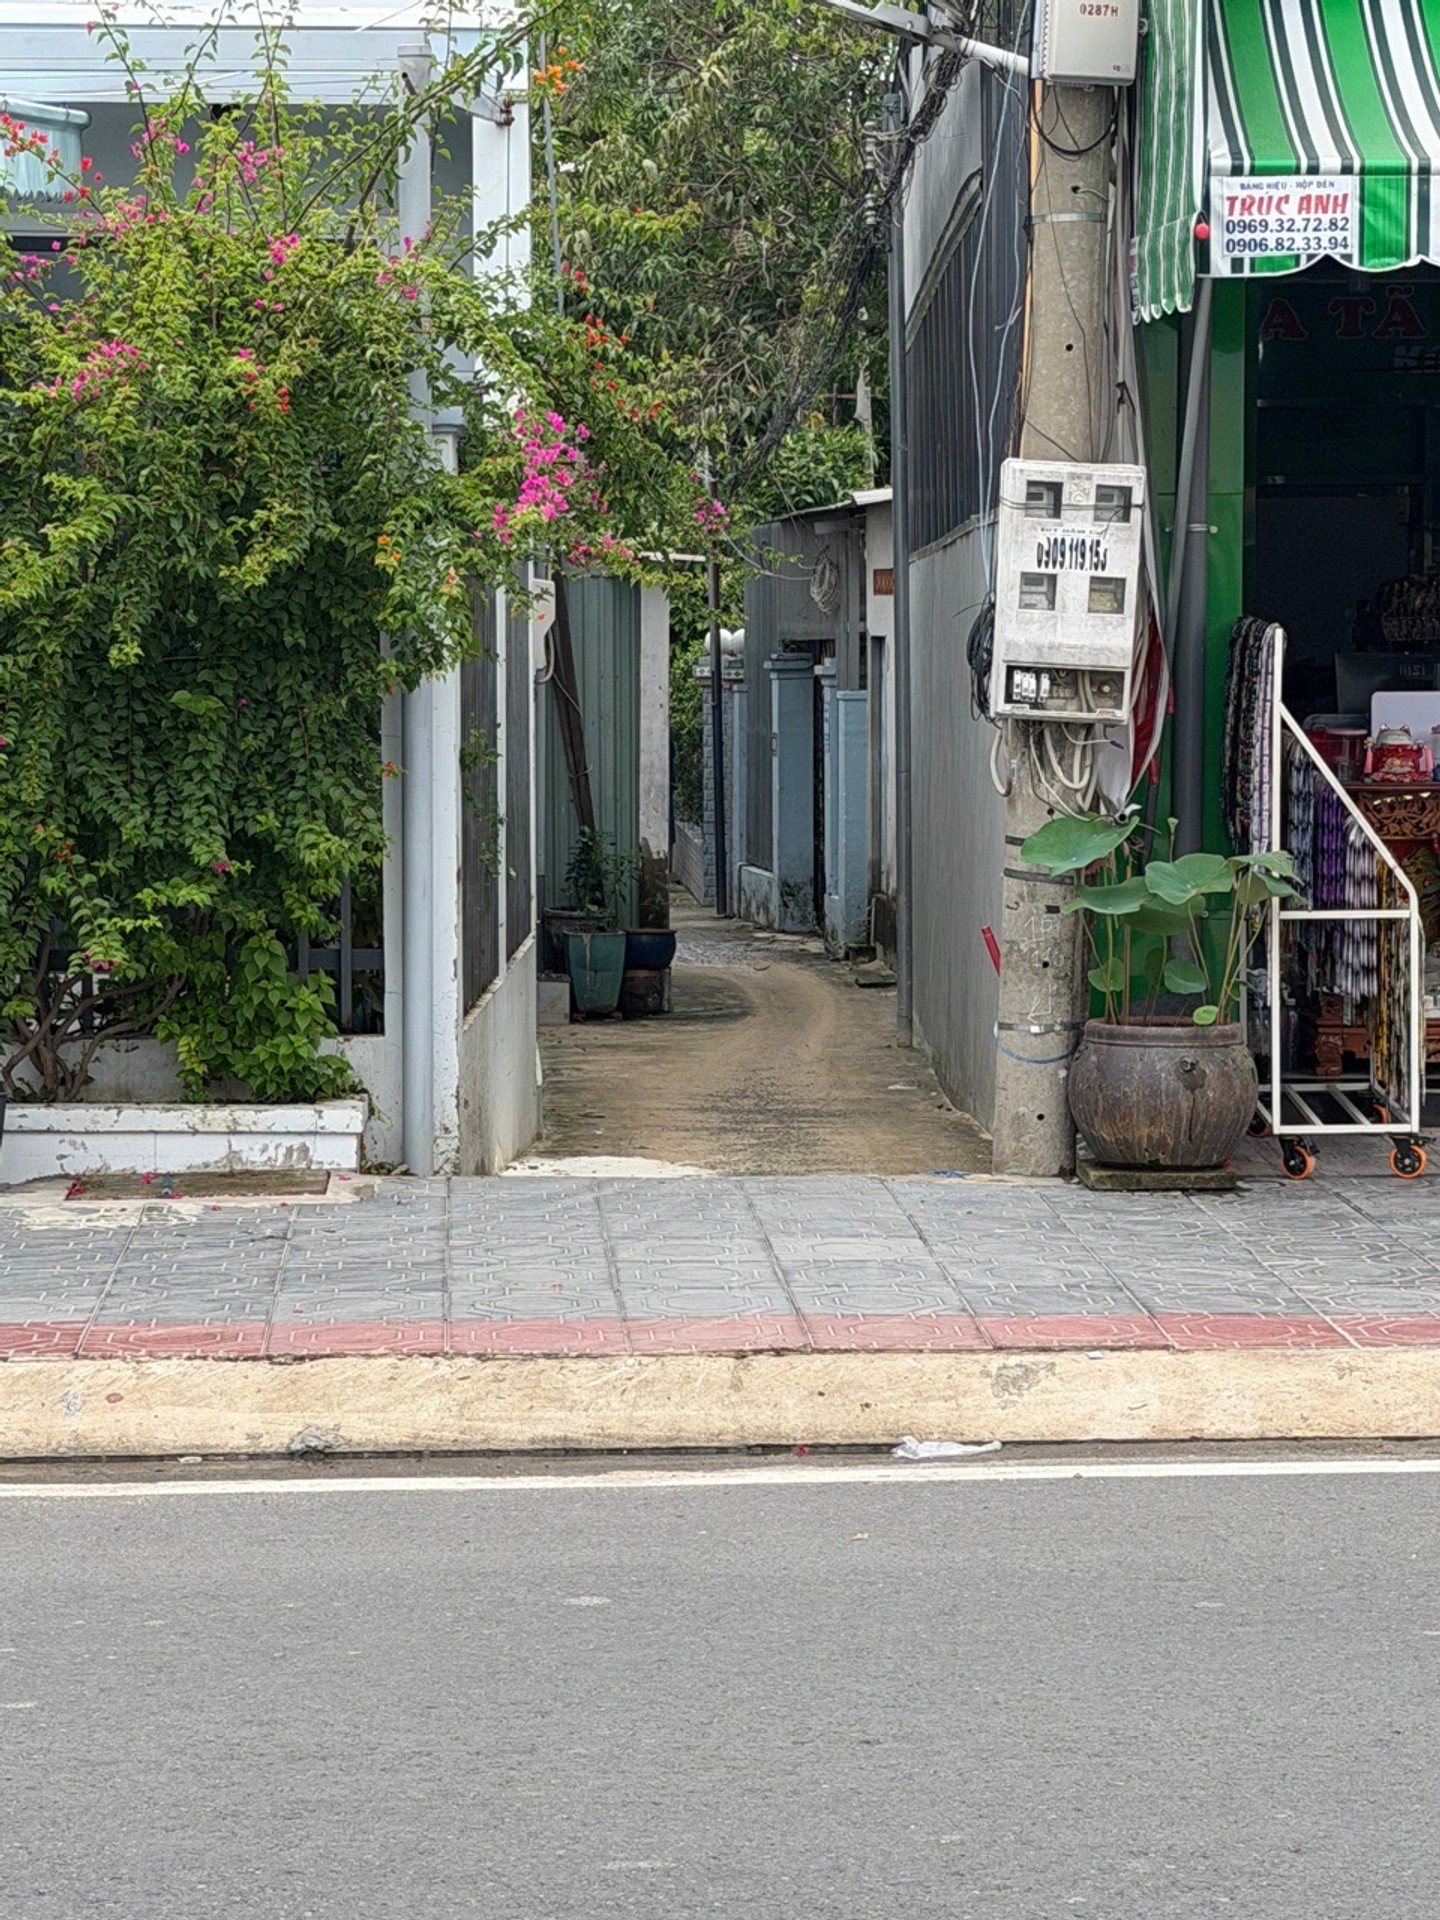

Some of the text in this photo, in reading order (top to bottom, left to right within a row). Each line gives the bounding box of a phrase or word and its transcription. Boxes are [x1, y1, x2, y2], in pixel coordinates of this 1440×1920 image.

[1080, 3, 1119, 17] 0287H
[1226, 191, 1349, 217] TRÚC ANH
[1225, 216, 1350, 235] 0969.32.72.82
[1225, 235, 1349, 253] 0906.82.33.94
